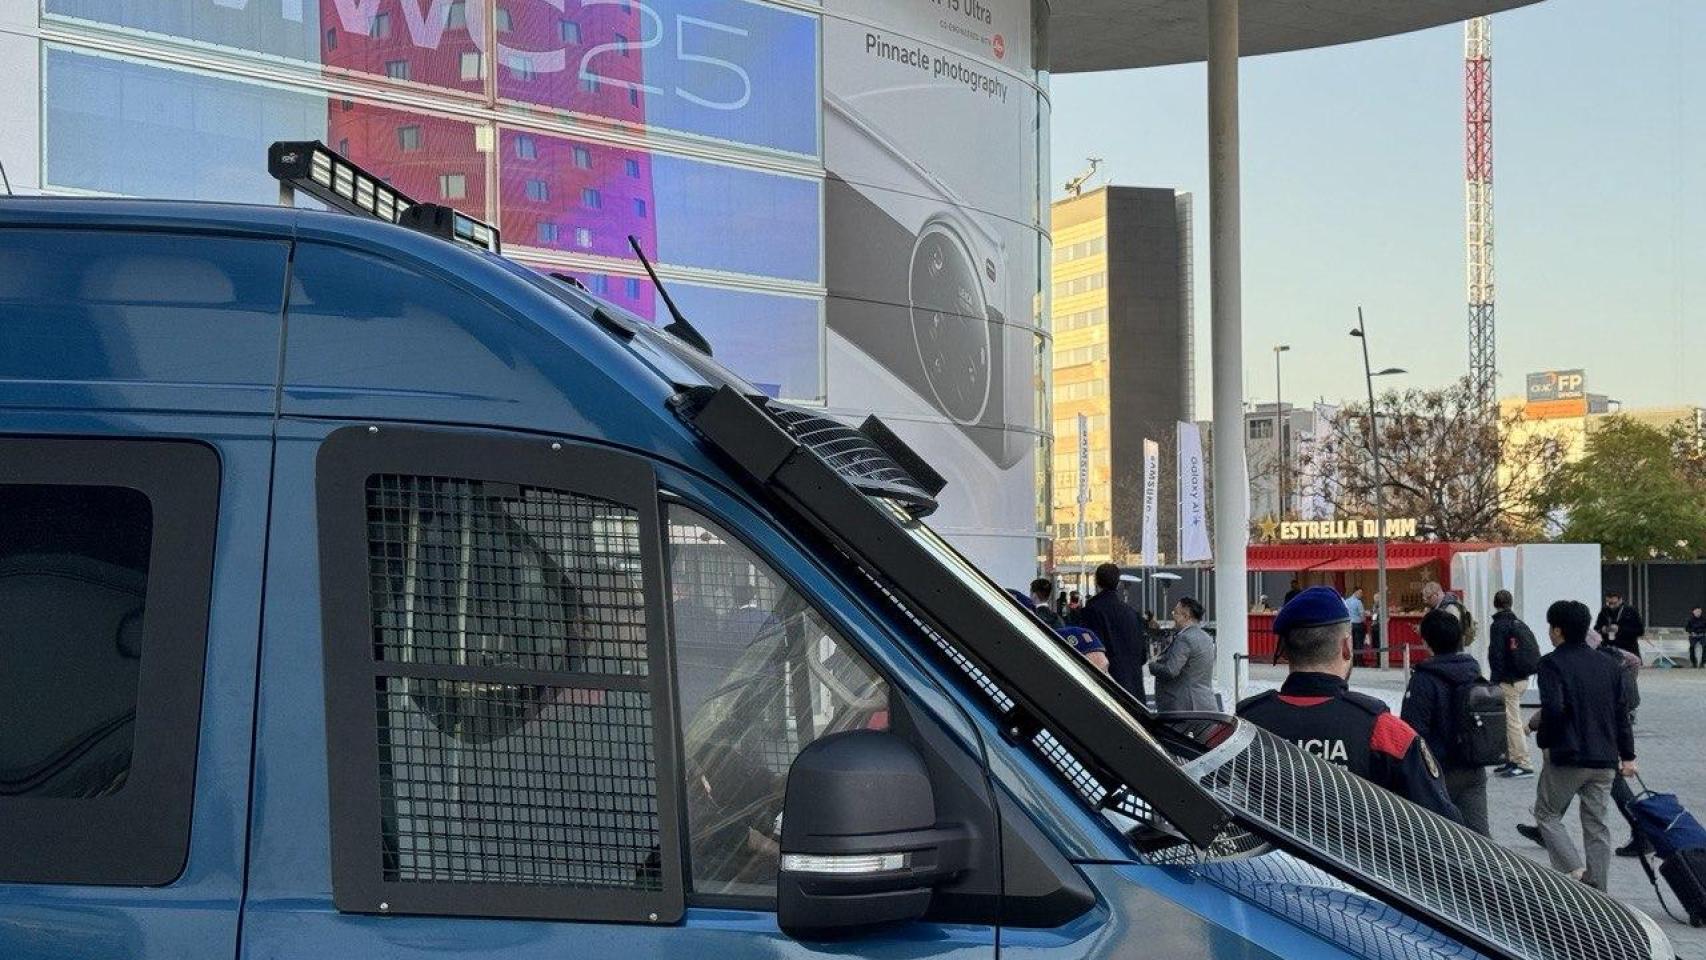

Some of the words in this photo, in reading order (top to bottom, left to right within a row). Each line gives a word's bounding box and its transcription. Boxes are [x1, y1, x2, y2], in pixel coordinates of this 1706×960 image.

[964, 0, 991, 25] Ultra
[865, 33, 930, 70] Pinnacle
[933, 56, 1008, 103] photography
[1558, 374, 1582, 391] FP
[1280, 520, 1358, 539] ESTRELLA
[1363, 518, 1415, 537] DMM
